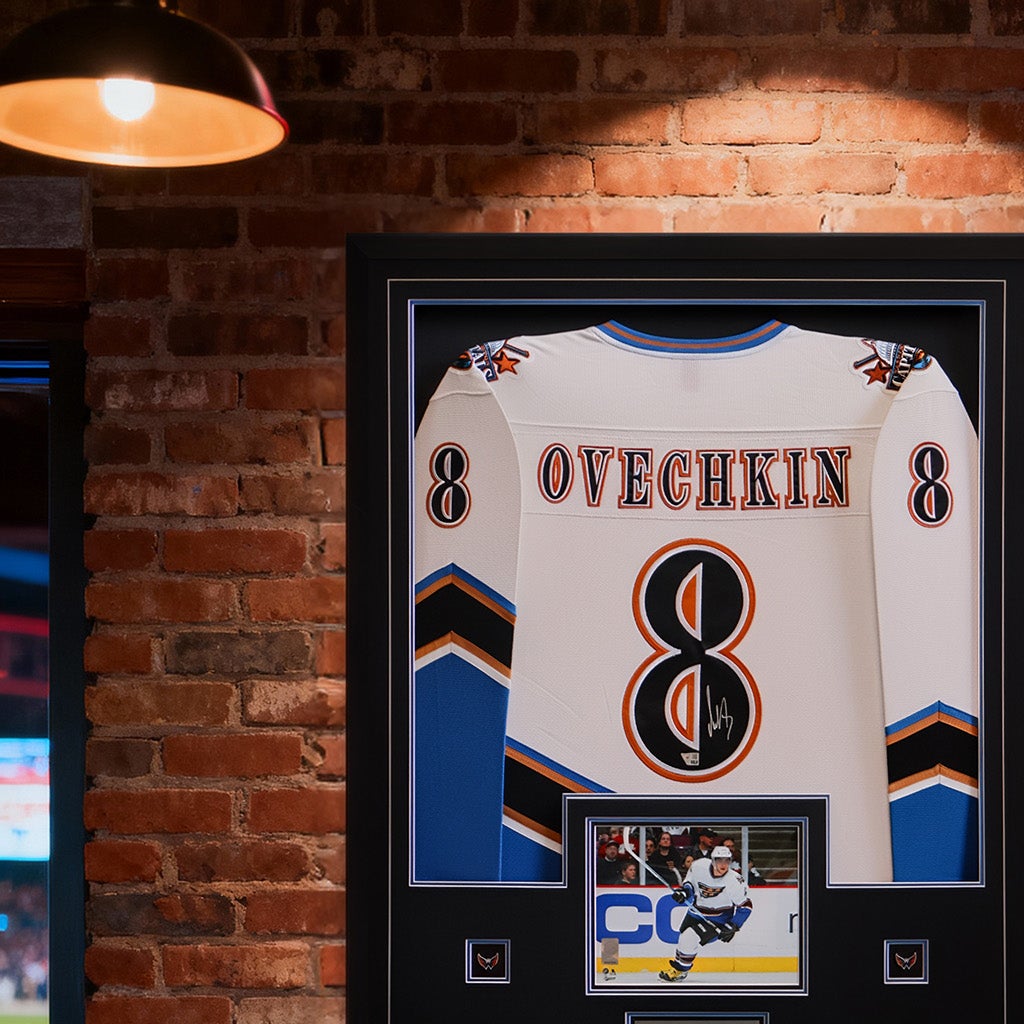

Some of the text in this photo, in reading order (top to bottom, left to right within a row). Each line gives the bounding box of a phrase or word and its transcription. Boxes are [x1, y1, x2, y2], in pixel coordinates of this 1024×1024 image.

[426, 441, 472, 529] 8
[537, 442, 852, 511] OVECHKIN
[907, 441, 954, 528] 8
[622, 538, 762, 782] 8
